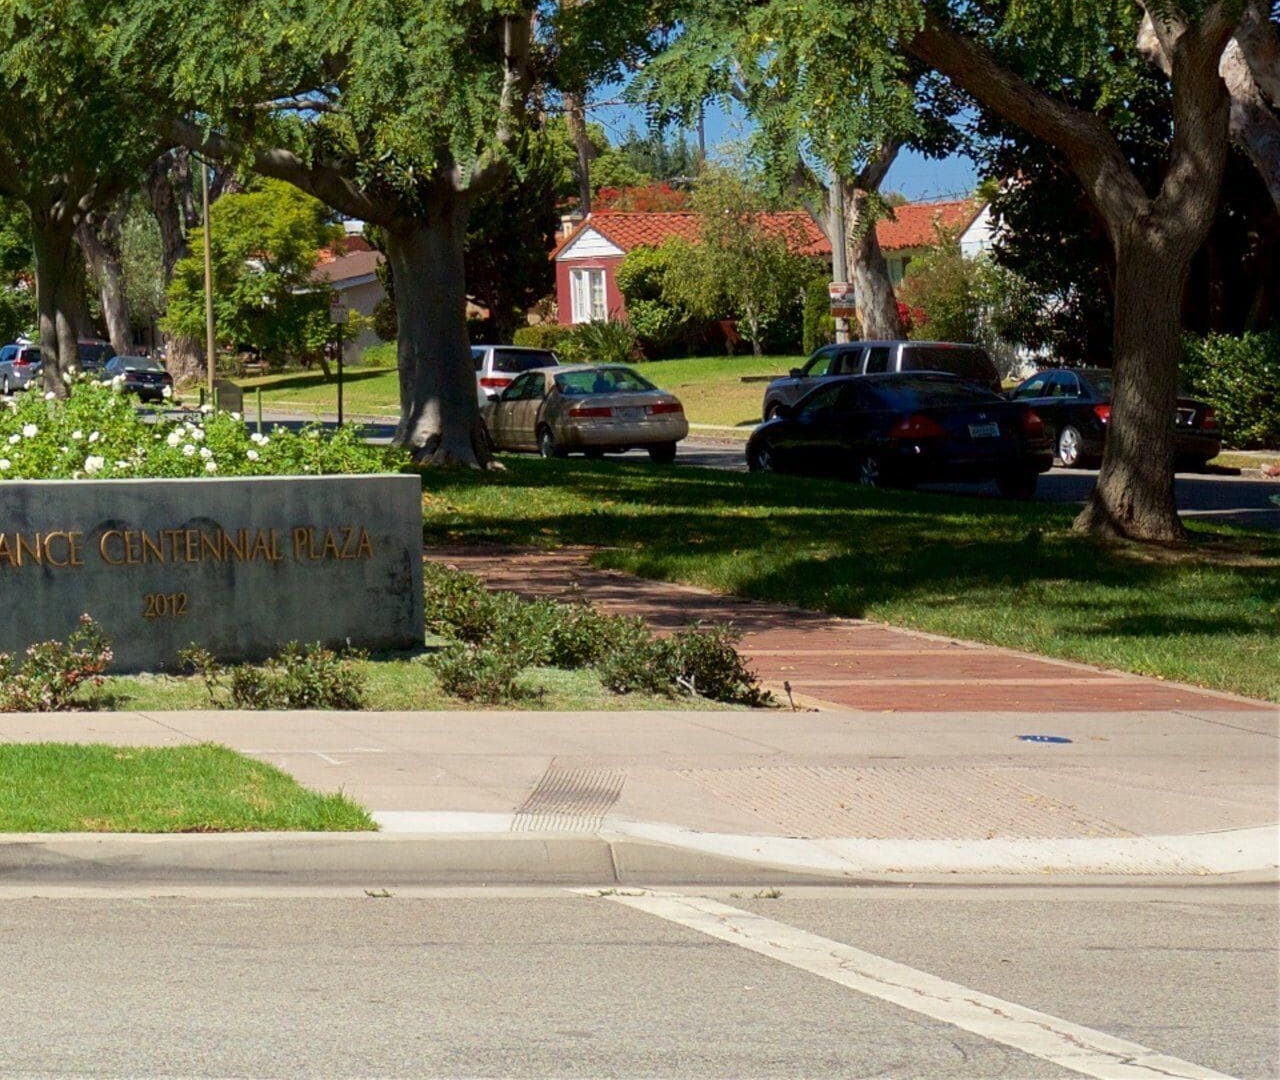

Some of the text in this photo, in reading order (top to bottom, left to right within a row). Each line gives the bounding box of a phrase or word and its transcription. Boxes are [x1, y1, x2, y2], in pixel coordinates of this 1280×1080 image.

[99, 528, 284, 566] CENTENNIAL
[293, 526, 374, 561] PLAZA
[143, 593, 188, 618] 2012
